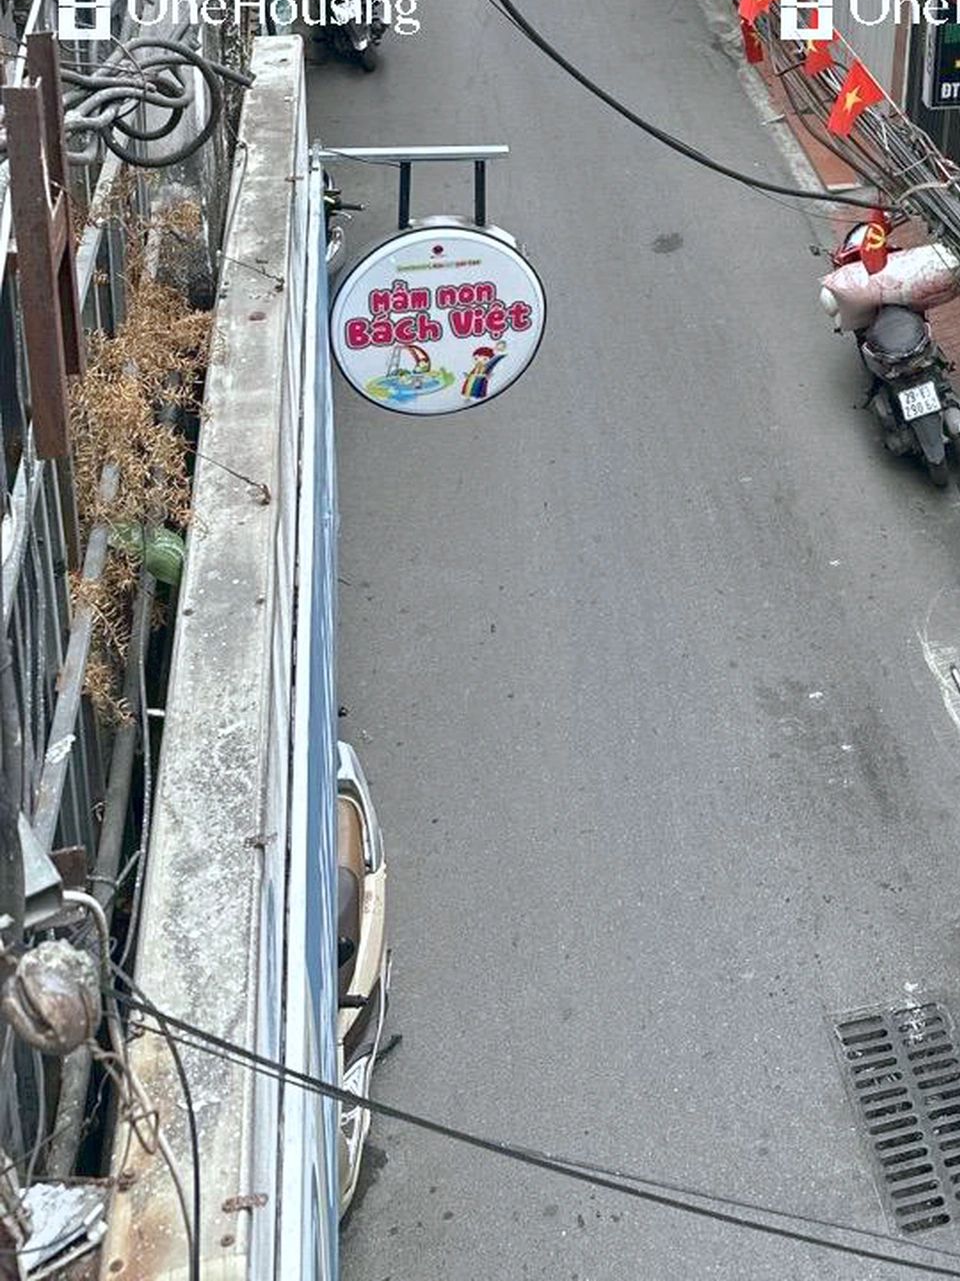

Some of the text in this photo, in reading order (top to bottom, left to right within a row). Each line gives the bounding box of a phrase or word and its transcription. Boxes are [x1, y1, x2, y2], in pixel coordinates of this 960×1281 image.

[435, 281, 497, 308] non
[344, 300, 533, 350] Bách Việt
